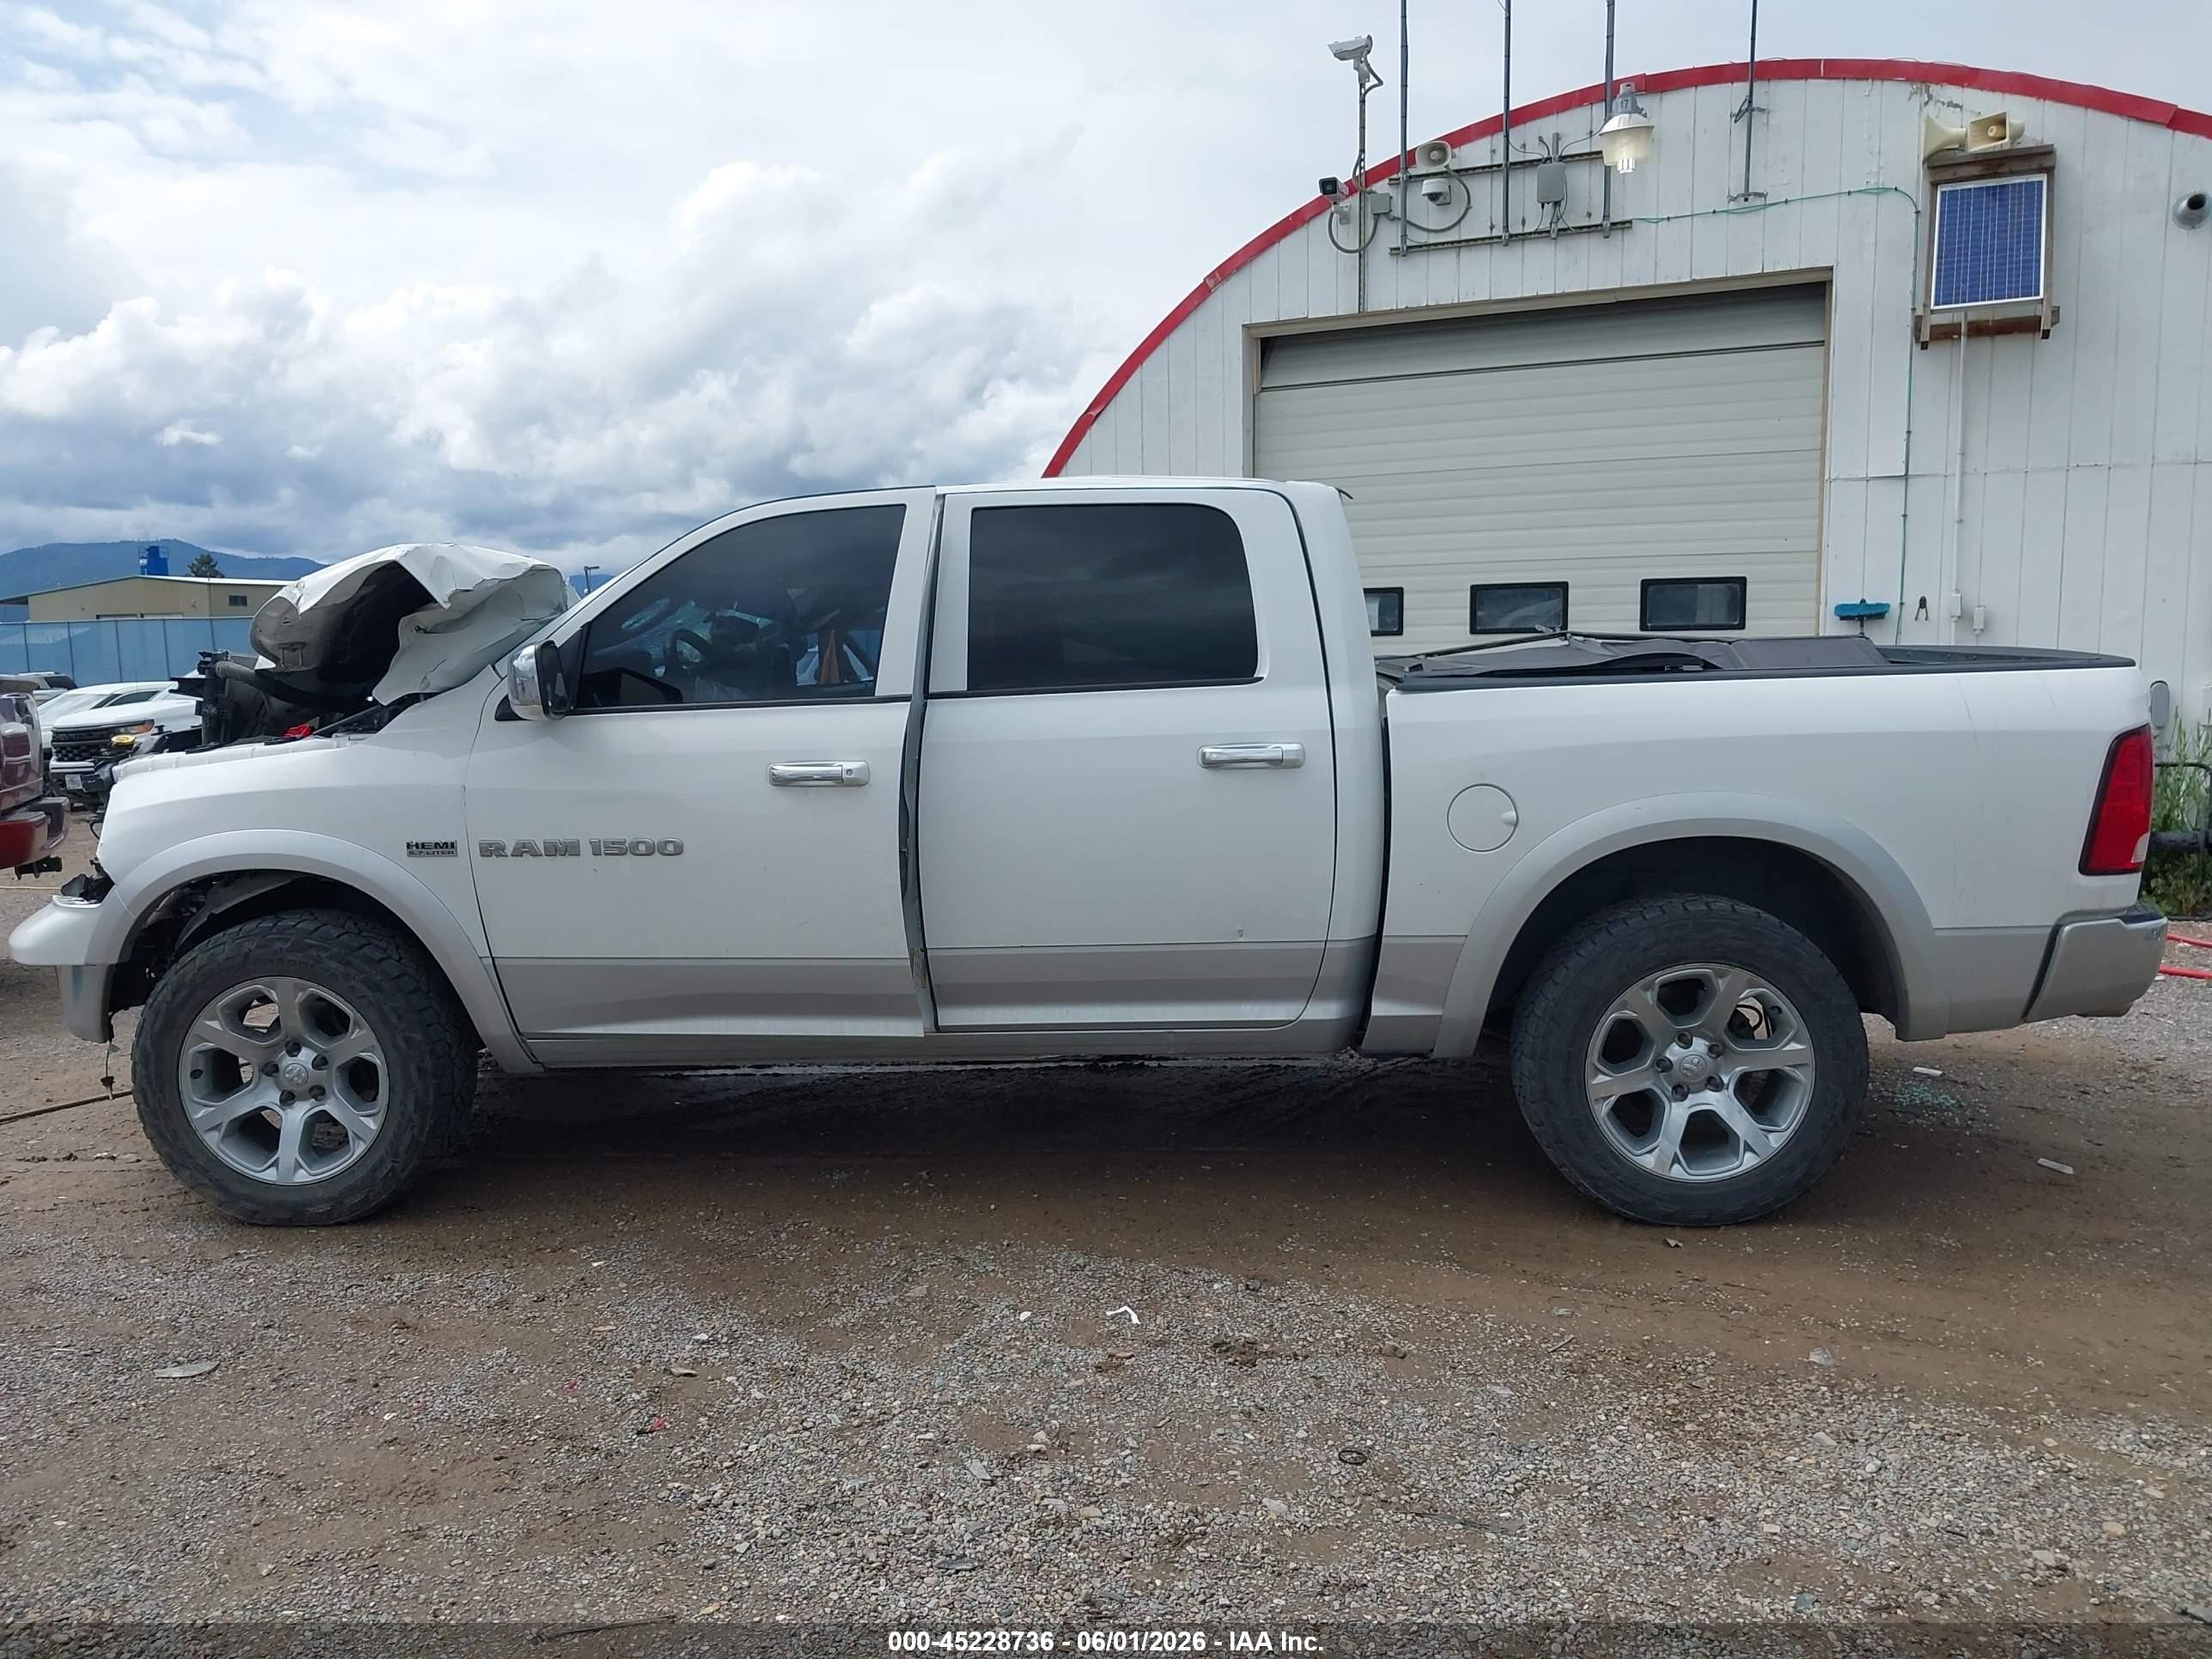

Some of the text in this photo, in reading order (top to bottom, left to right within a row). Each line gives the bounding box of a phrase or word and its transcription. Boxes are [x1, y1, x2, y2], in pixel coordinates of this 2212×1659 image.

[1620, 99, 1629, 110] 17
[406, 842, 455, 850] HEMI
[478, 837, 684, 857] RAM 1500
